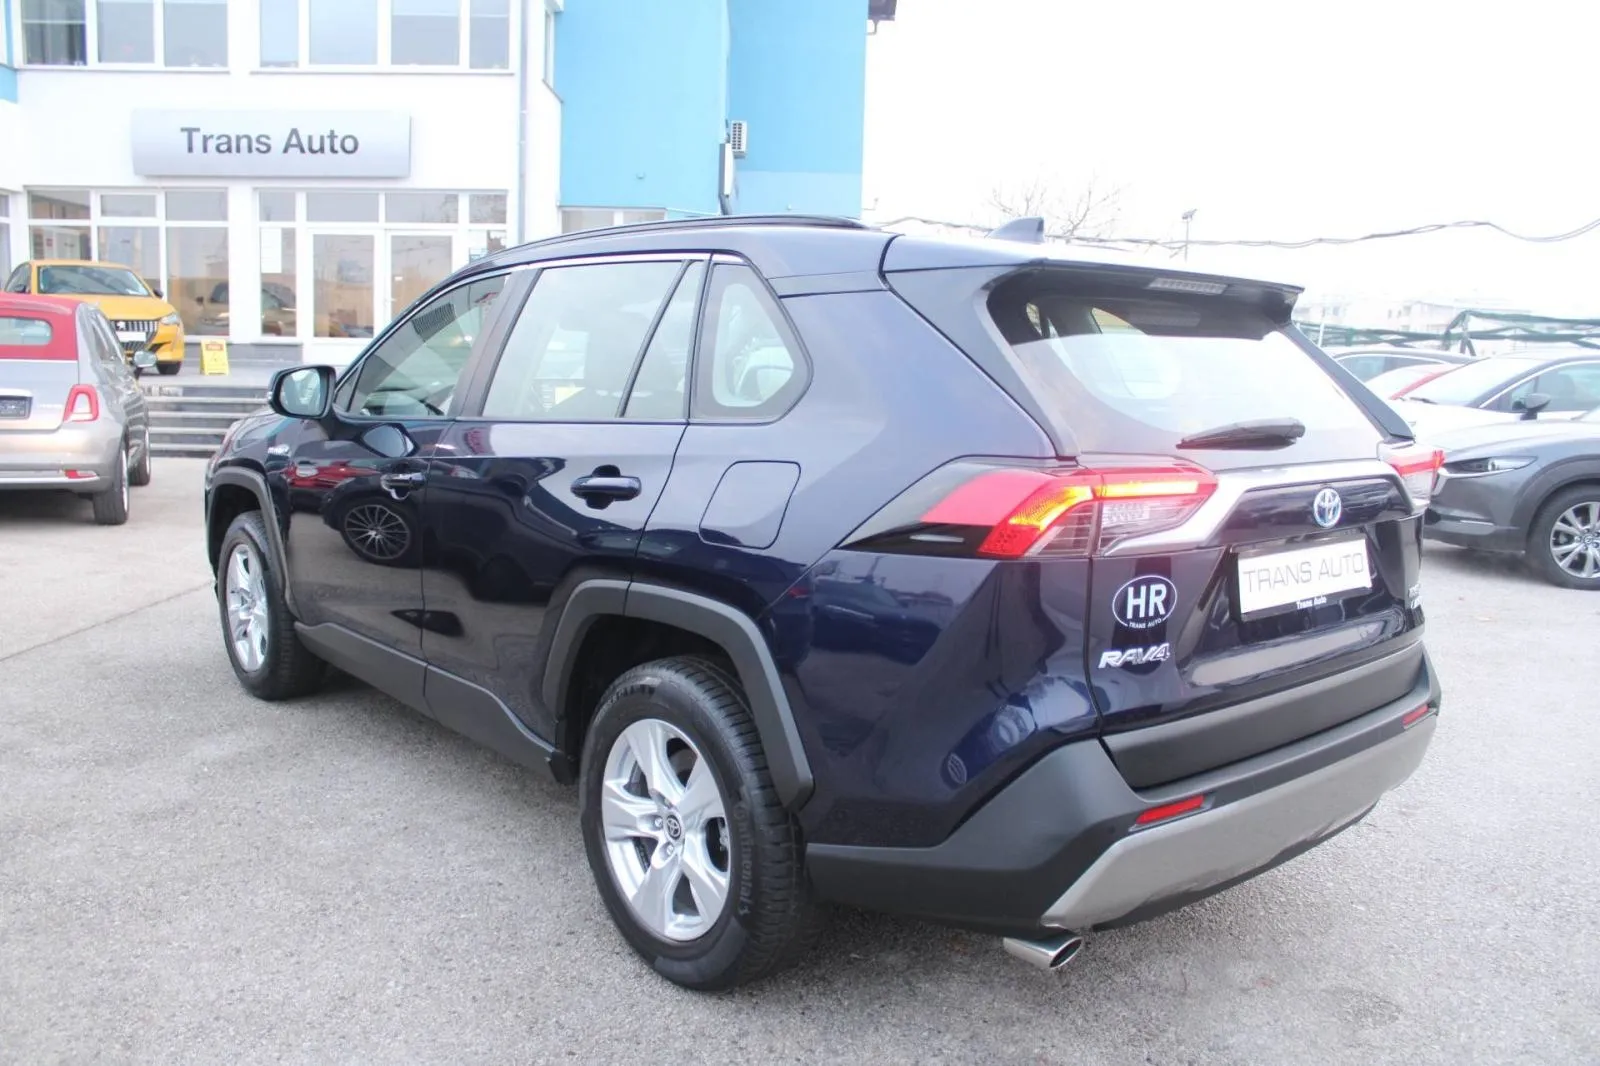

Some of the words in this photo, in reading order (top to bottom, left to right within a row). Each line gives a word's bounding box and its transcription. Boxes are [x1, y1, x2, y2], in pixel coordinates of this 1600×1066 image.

[180, 127, 272, 154] Trans
[282, 127, 360, 154] Auto
[1242, 561, 1312, 593] TRANS
[1318, 552, 1365, 580] AUTO
[1126, 583, 1167, 619] HR
[1296, 600, 1313, 610] Trans
[1313, 595, 1327, 605] Auto
[1129, 621, 1146, 629] TRANS
[1147, 618, 1162, 628] AUTO
[1098, 642, 1171, 669] RAV4
